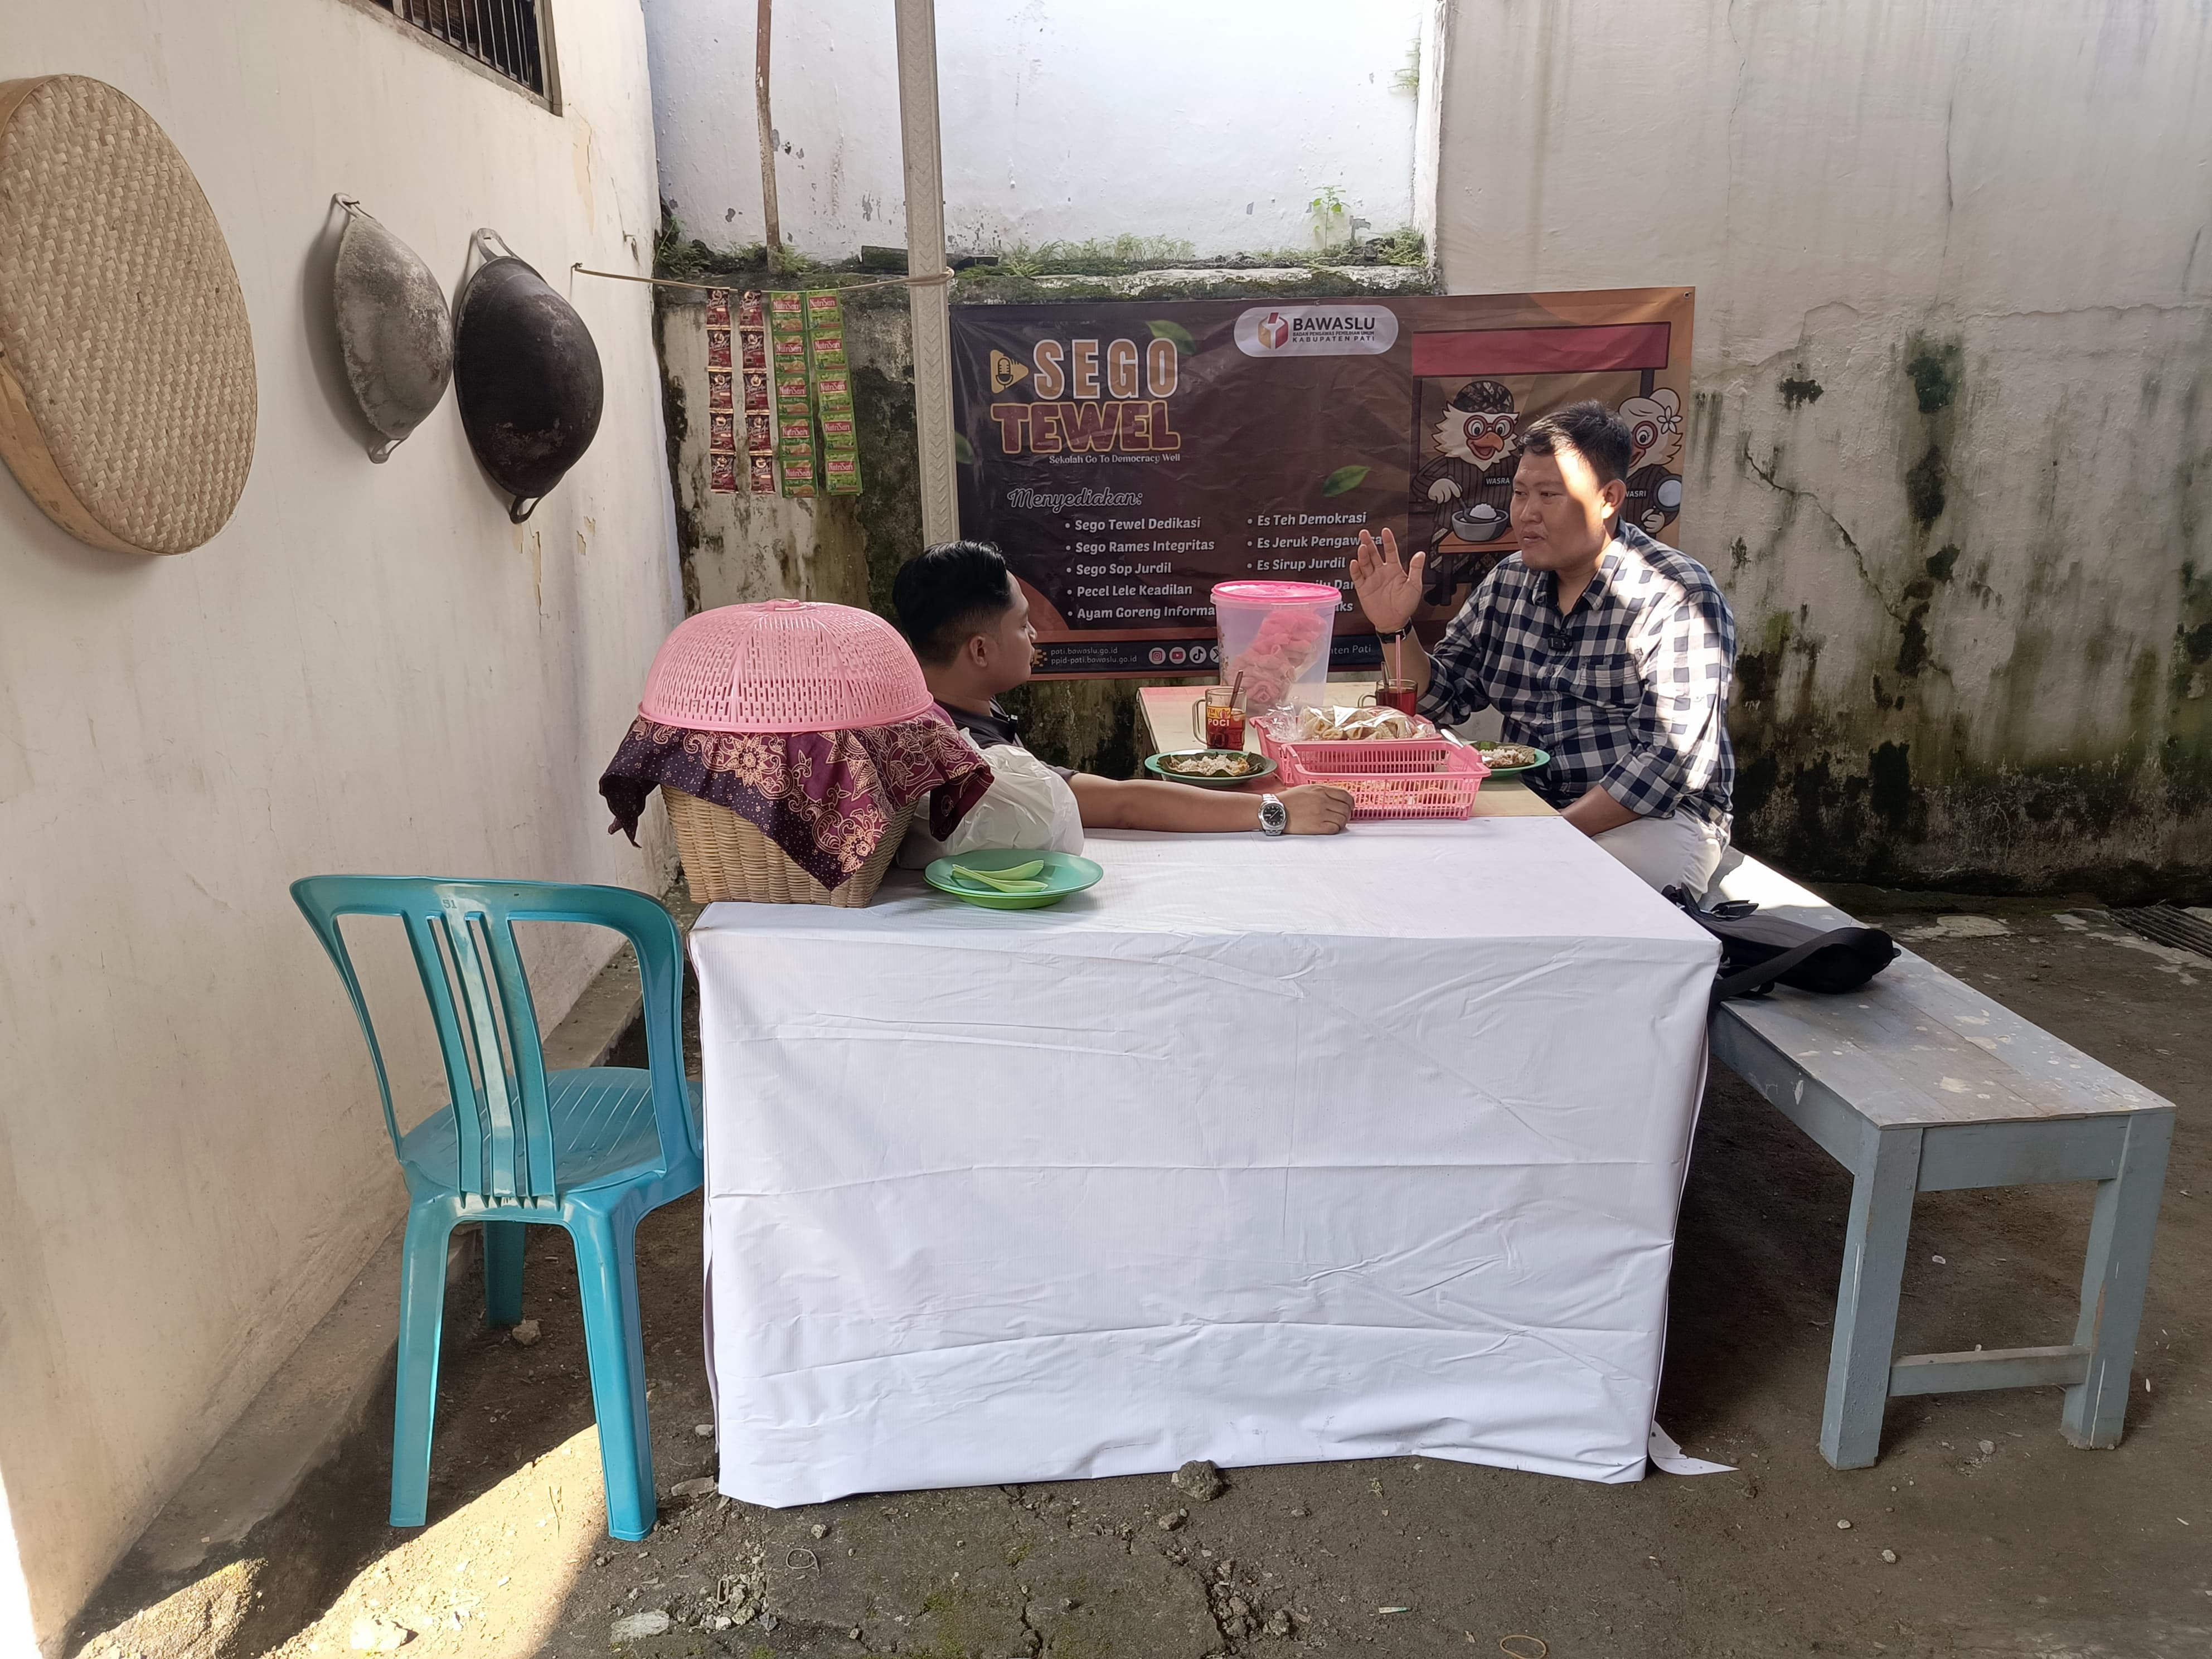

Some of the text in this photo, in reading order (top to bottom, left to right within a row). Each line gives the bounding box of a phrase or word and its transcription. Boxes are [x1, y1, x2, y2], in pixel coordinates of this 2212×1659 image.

[1293, 317, 1375, 331] BAWASLU
[1033, 338, 1178, 400] SEGO
[991, 400, 1181, 454] TEWEL
[1049, 453, 1180, 464] Sekolah Go To Democracy Well
[1007, 487, 1143, 513] Menyediakan:
[1075, 517, 1201, 533] Sego Tewel Dedikasi
[1257, 512, 1366, 526] Es Teh Demokrasi
[1075, 540, 1215, 555] Sego Rames Integritas
[1257, 537, 1270, 548] Es
[1272, 536, 1308, 547] Jeruk
[1076, 562, 1171, 577] Sego Sop Jurdil
[1257, 557, 1345, 571] Es Sirup Jurdil
[1077, 584, 1192, 597] Pecel Lele Keadilan
[1077, 606, 1215, 620] Ayam Goreng Informa
[1051, 647, 1118, 656] pati.bawaslu.go.id
[1352, 644, 1371, 653] Pati
[1051, 655, 1137, 665] ppid-pati.bawaslu.go.id
[1208, 718, 1230, 726] POCI
[442, 899, 457, 909] 51
